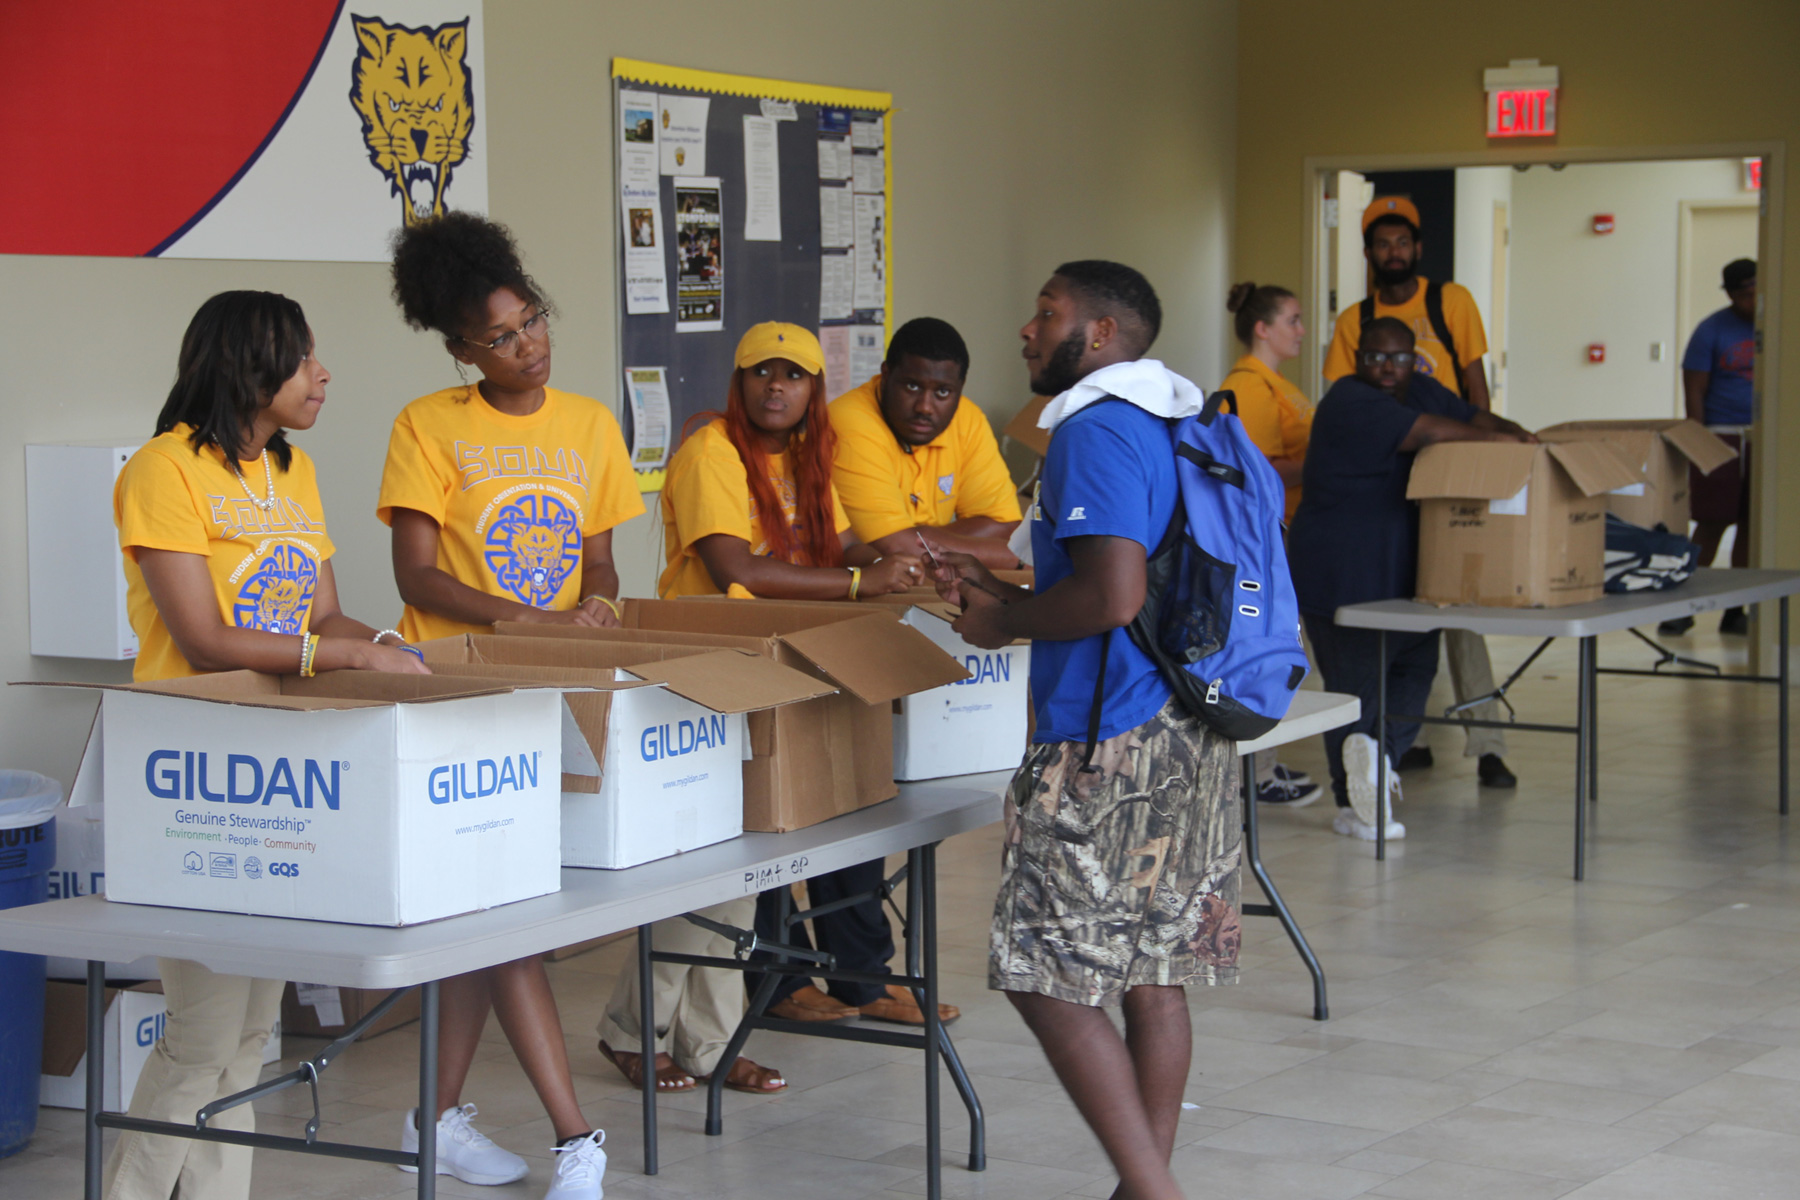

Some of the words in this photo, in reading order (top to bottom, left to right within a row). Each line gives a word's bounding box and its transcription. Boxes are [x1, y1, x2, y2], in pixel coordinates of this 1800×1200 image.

[1497, 89, 1550, 133] EXIT
[475, 503, 495, 535] STUDENT
[493, 483, 538, 505] ORIENTATION
[546, 484, 580, 510] UNIVERSITY
[229, 552, 257, 584] STUDENT
[175, 809, 226, 826] Genuine
[455, 817, 515, 835] www.mygildan.com
[165, 827, 222, 842] Environment
[264, 837, 316, 854] Community
[268, 862, 300, 878] GQS
